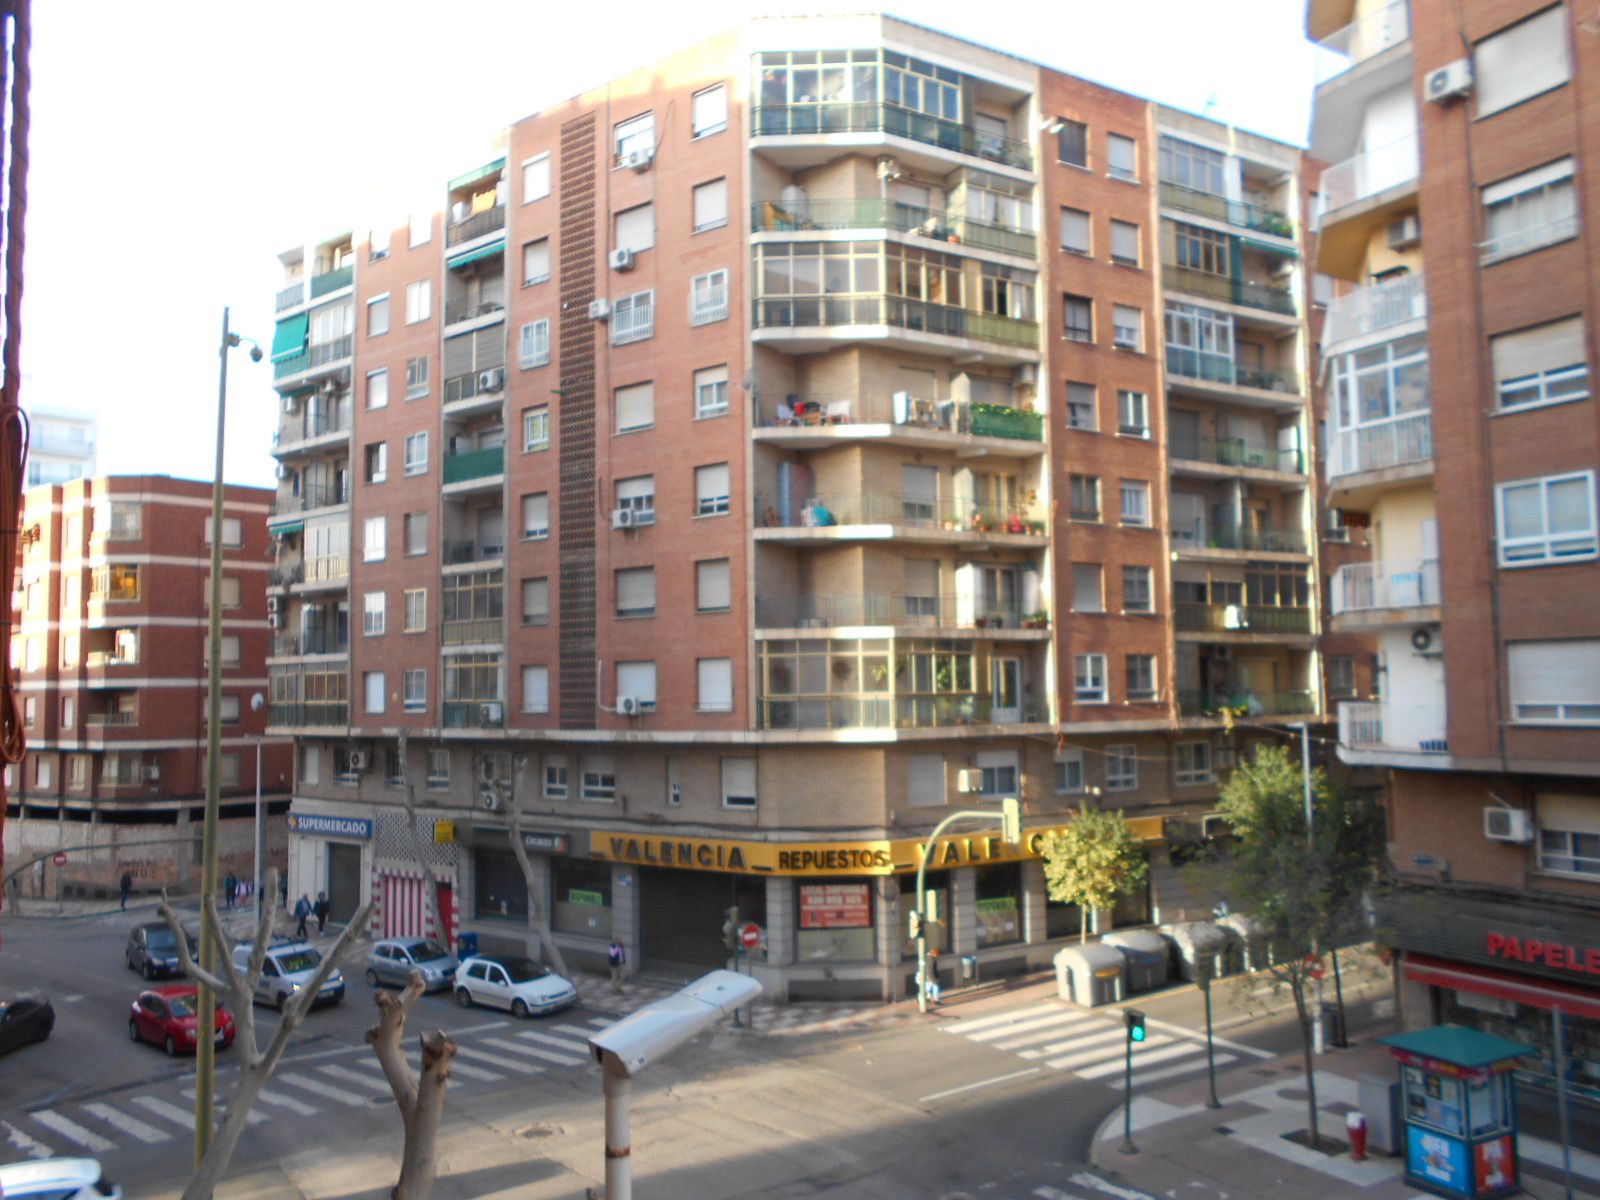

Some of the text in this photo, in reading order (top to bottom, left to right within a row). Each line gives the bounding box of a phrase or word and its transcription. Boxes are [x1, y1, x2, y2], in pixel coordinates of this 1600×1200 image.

[298, 816, 366, 834] SUPERMERCADO
[610, 837, 746, 869] VALENCIA
[778, 849, 890, 869] REPUESTOS
[1486, 932, 1600, 975] PAPELE
